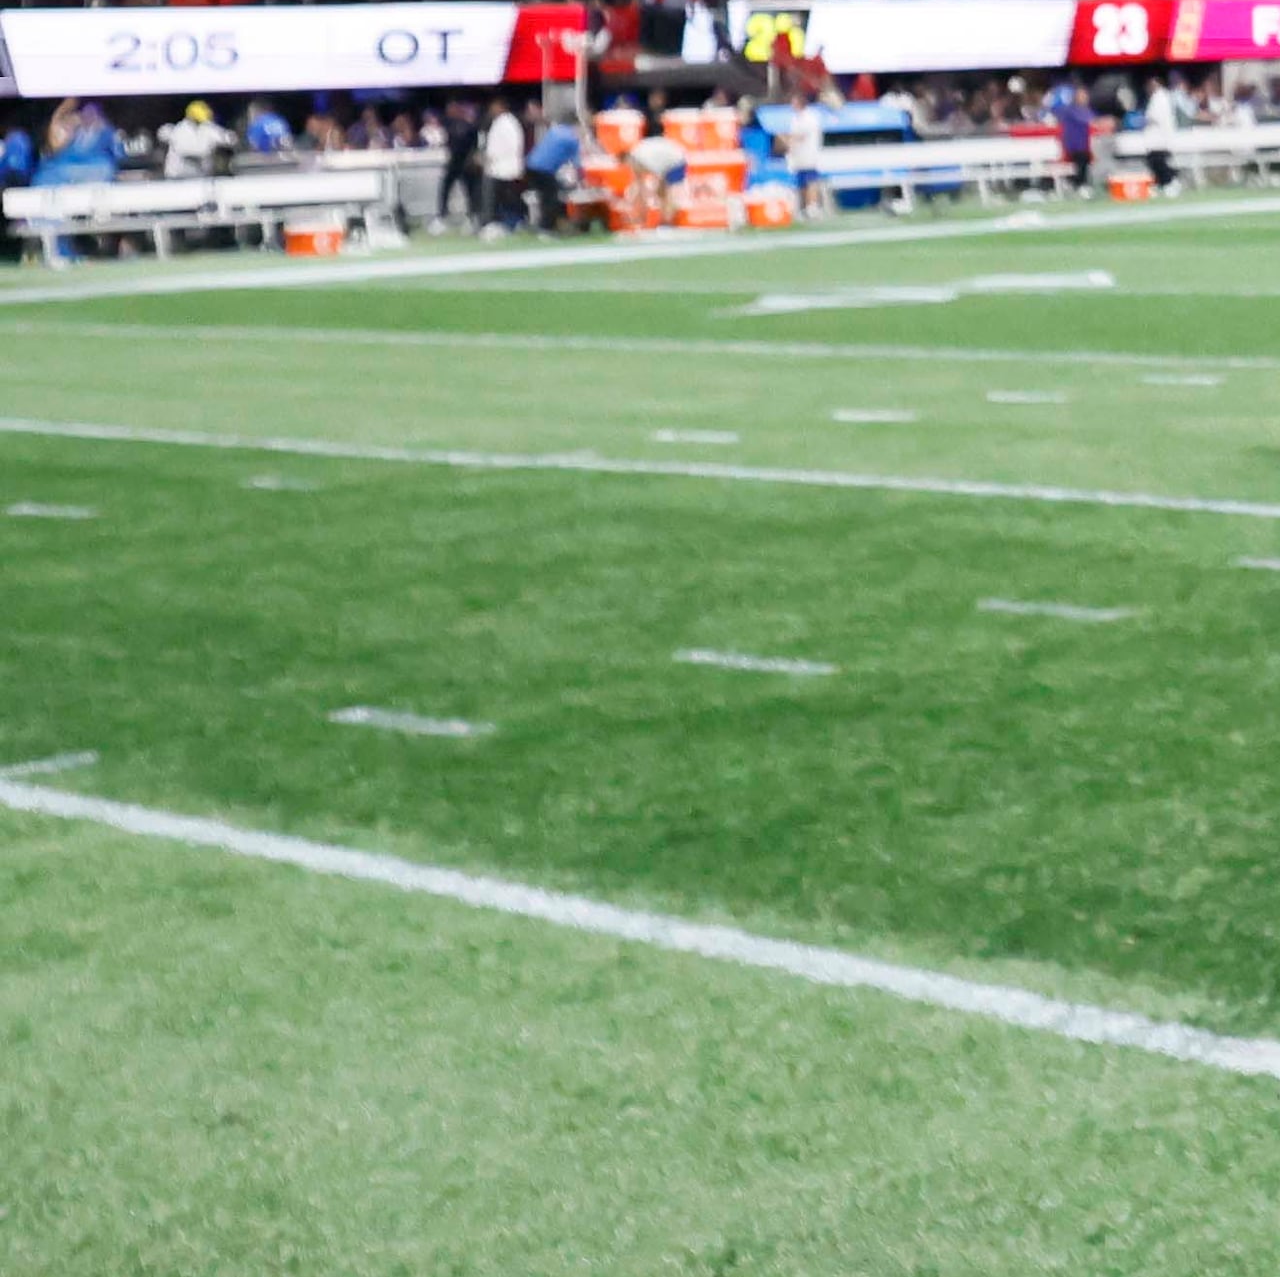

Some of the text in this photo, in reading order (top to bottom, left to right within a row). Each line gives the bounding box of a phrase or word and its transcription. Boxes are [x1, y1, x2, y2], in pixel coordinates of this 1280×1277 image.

[106, 28, 463, 72] 2:05 OT
[1092, 3, 1149, 55] 23
